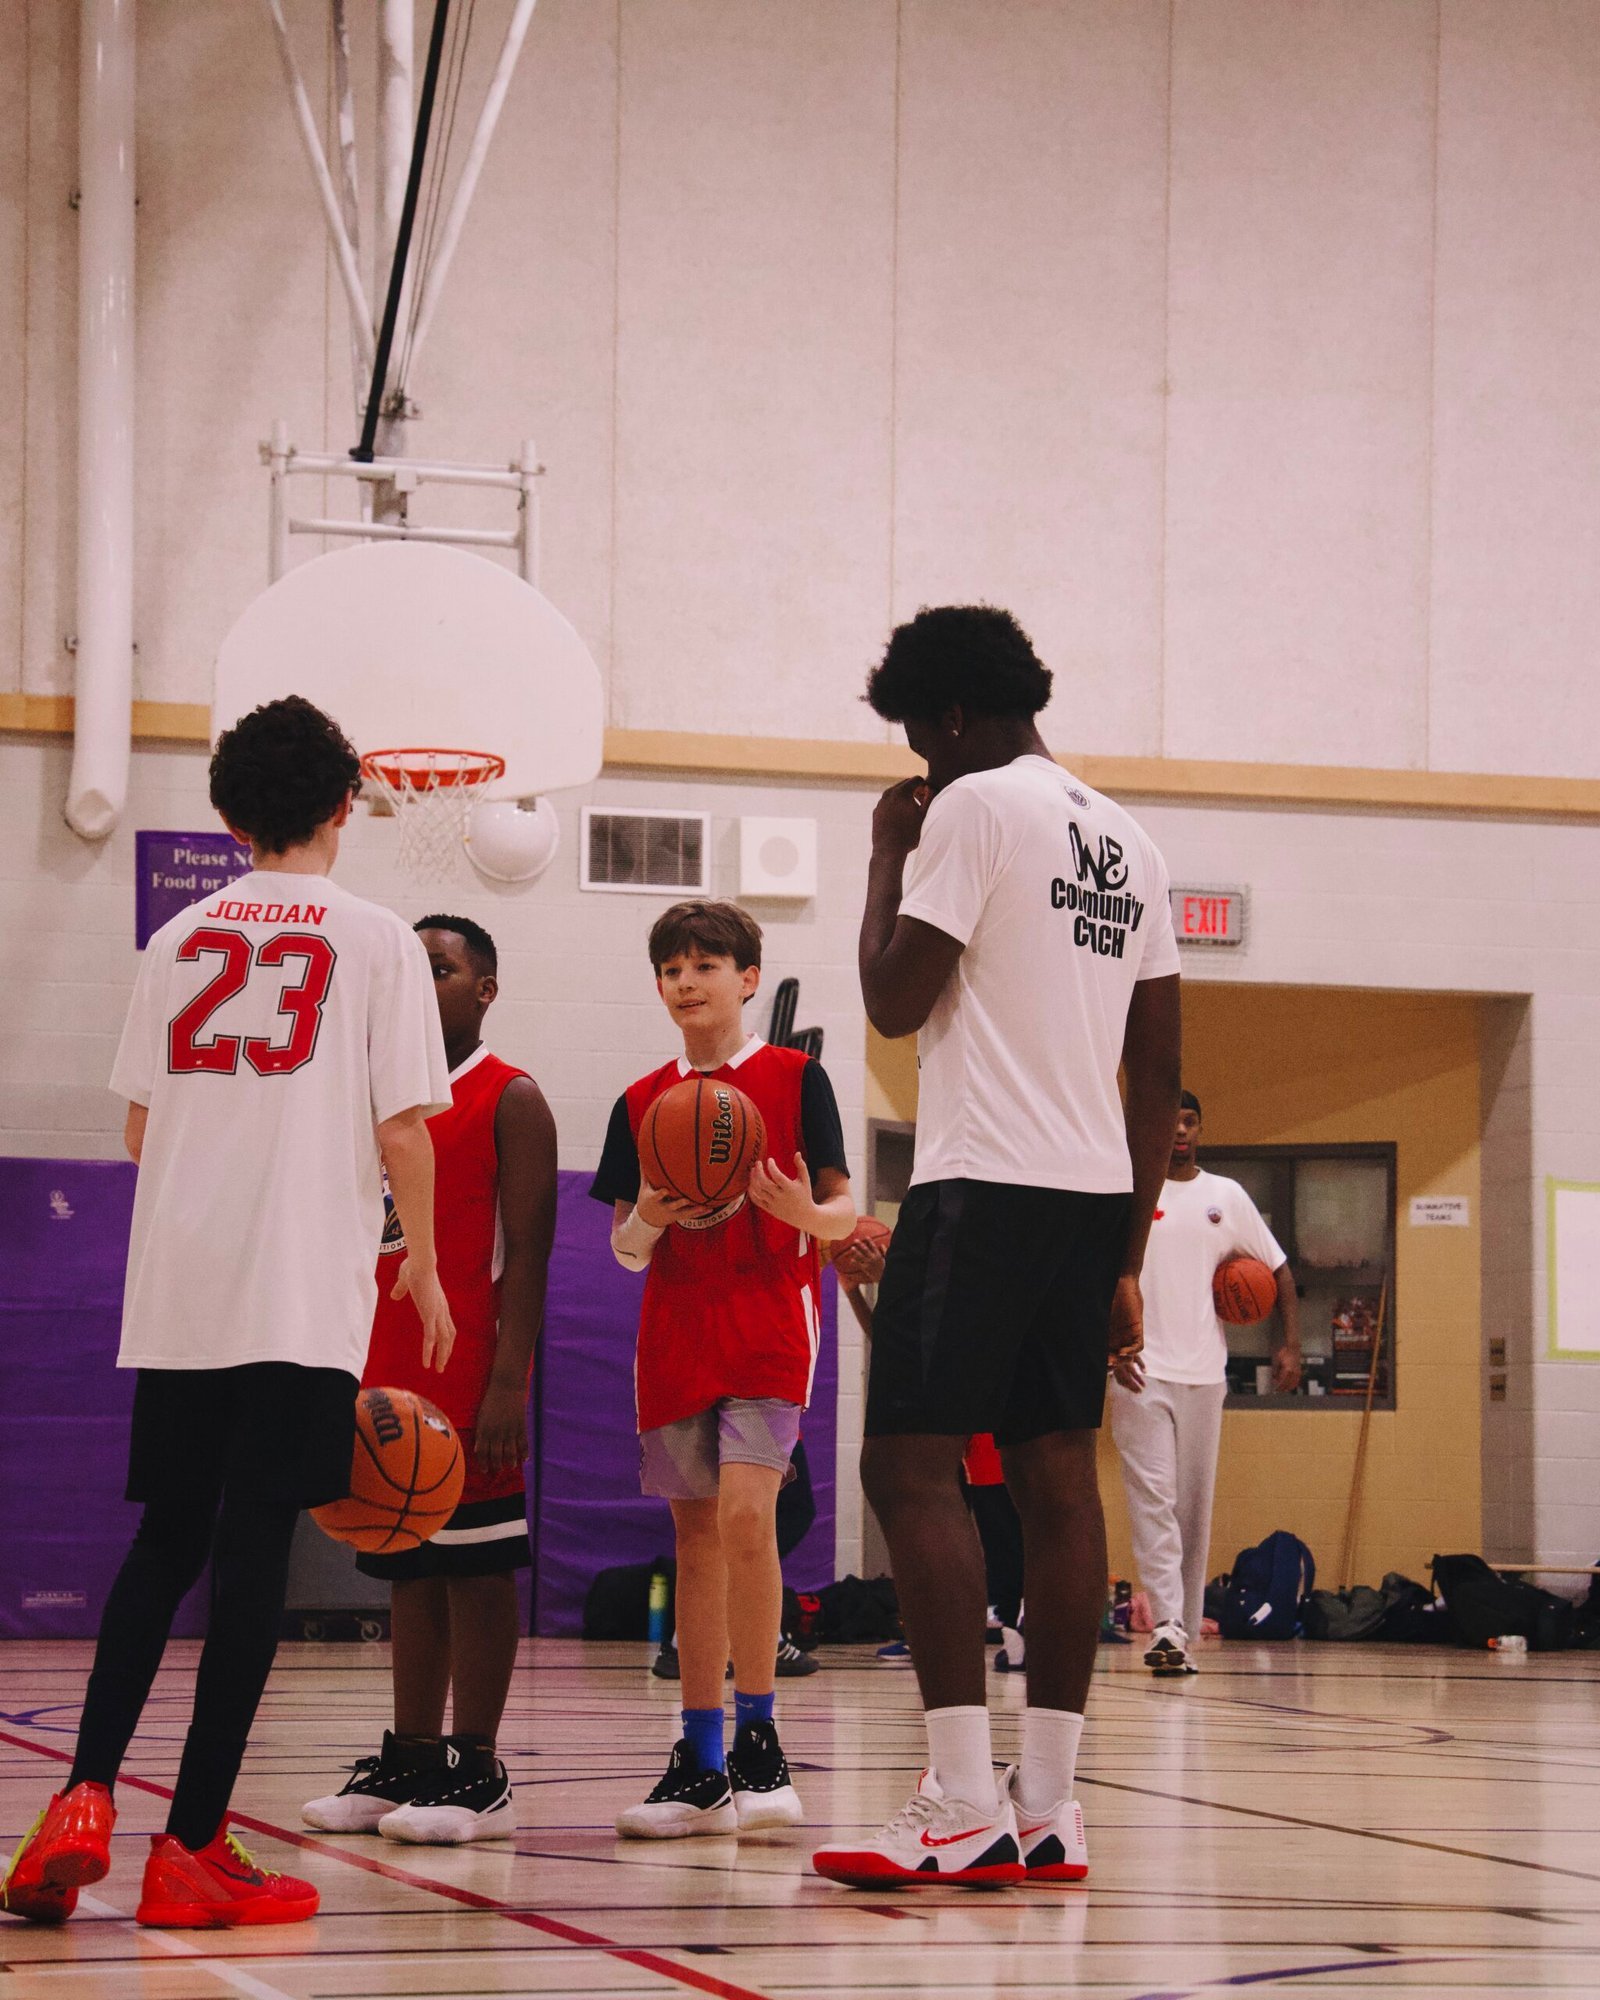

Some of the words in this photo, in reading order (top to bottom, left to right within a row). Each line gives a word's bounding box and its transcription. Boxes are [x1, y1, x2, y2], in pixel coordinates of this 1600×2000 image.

[173, 848, 228, 867] Please
[152, 872, 197, 890] Food
[202, 877, 222, 890] or
[206, 900, 328, 926] JORDAN
[1183, 896, 1231, 935] EXIT
[168, 927, 338, 1076] 23
[708, 1088, 733, 1165] Wilson
[380, 1240, 407, 1252] TIONS
